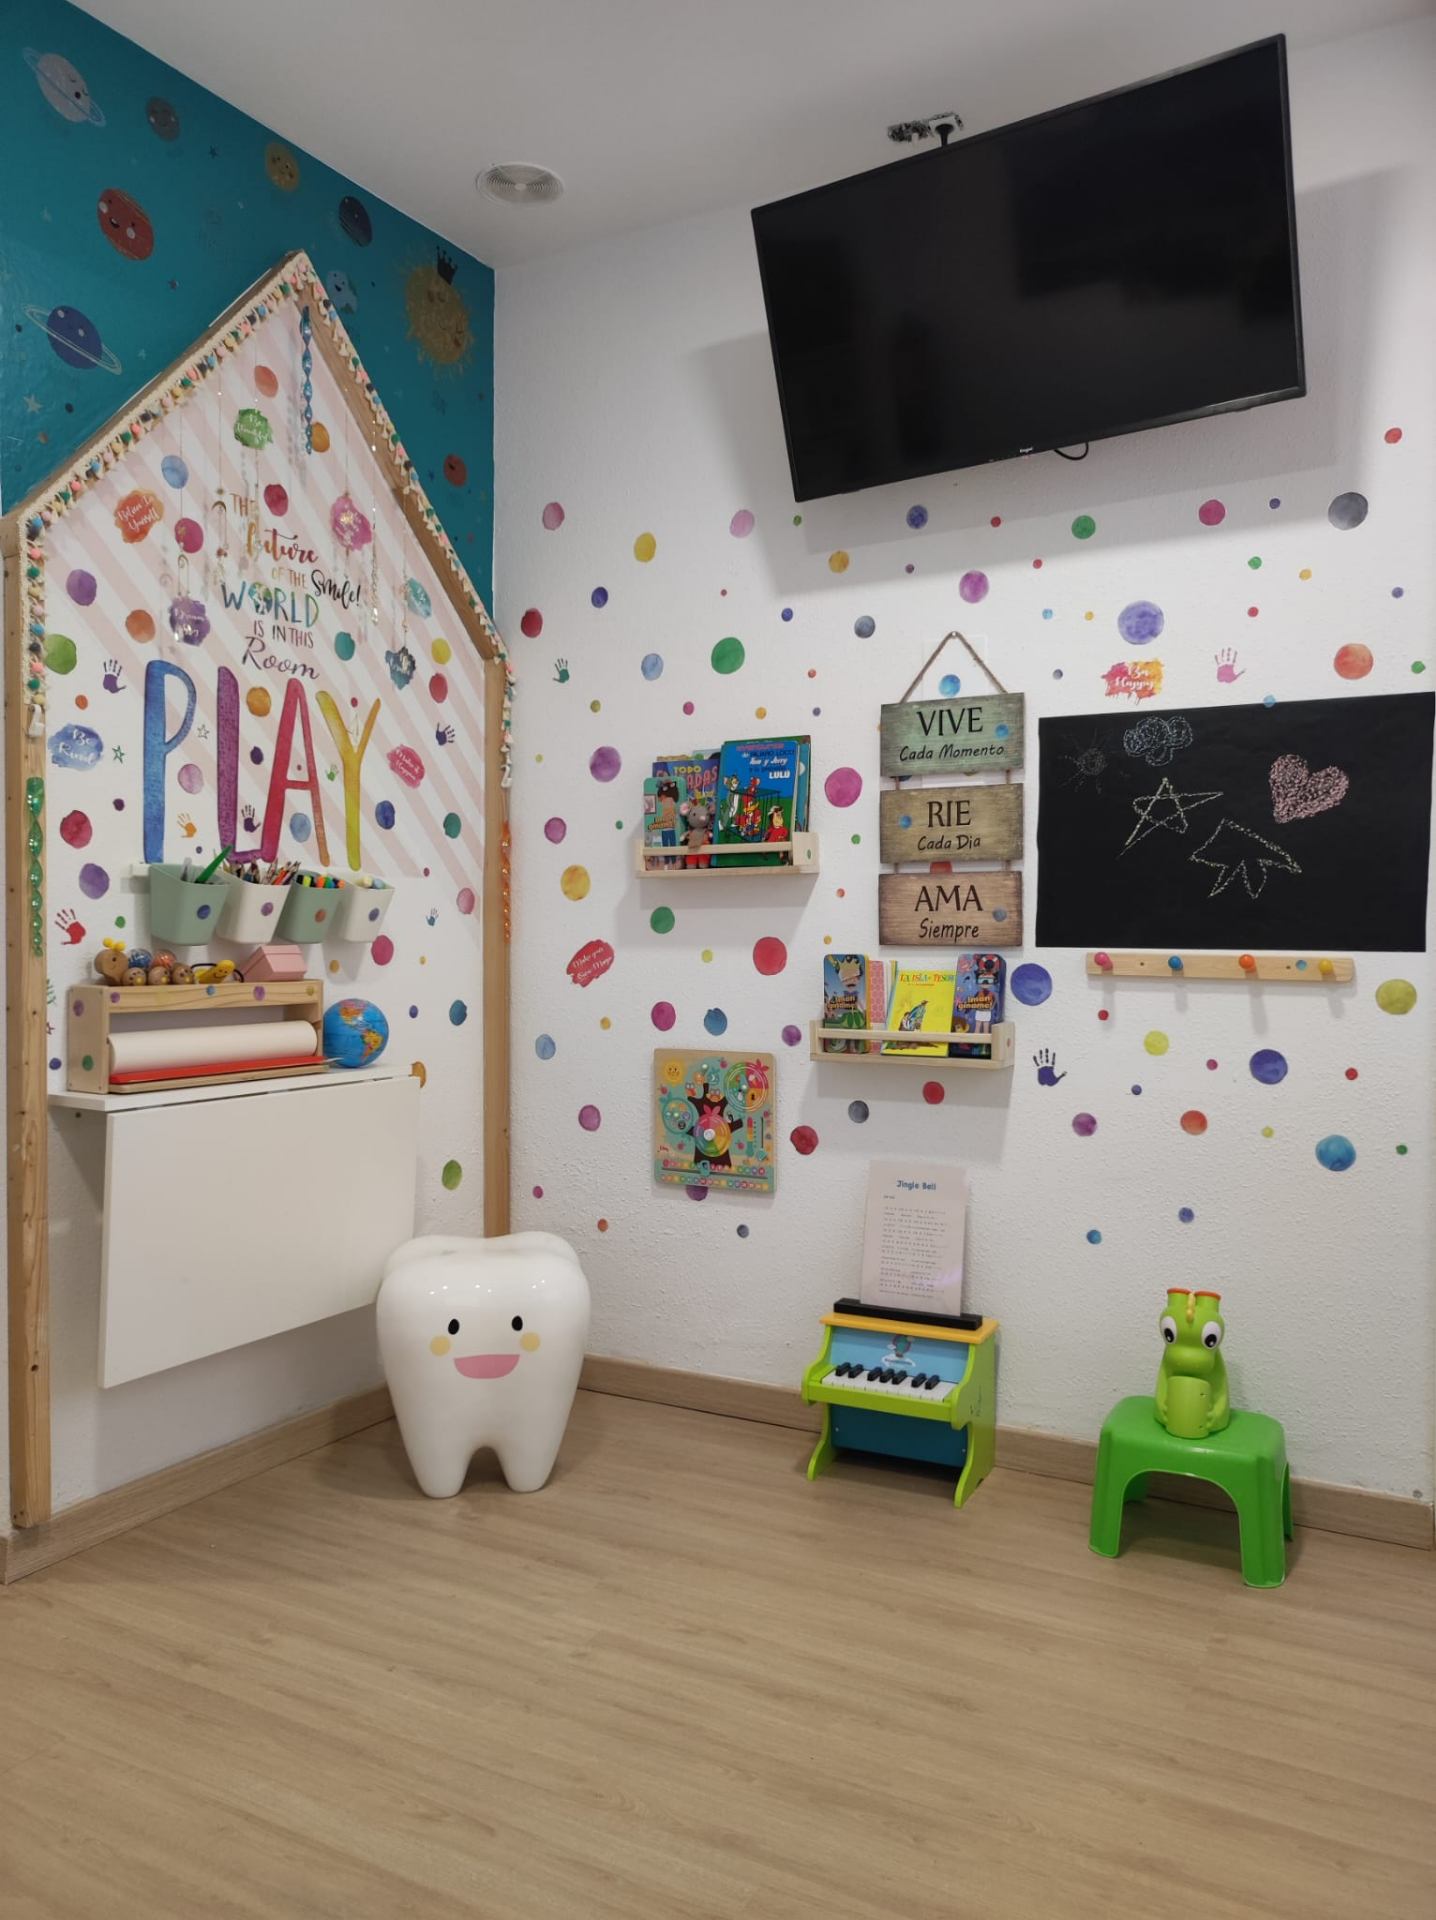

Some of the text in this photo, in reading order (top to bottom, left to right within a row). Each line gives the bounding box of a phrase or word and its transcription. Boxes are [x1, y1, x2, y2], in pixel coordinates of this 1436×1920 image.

[271, 566, 283, 581] OF
[287, 568, 308, 590] THE
[221, 580, 320, 628] WORLD
[253, 619, 315, 650] IS IN THIS
[241, 636, 320, 680] Room
[917, 706, 984, 736] VIVE
[72, 729, 92, 745] Be
[899, 743, 1005, 761] Cada Momento
[143, 660, 381, 871] PLAY
[672, 764, 702, 774] TODO
[926, 800, 971, 828] RIE
[917, 834, 951, 851] Cada
[914, 884, 984, 912] AMA
[918, 918, 980, 942] Siempre
[896, 1180, 919, 1191] Jingle
